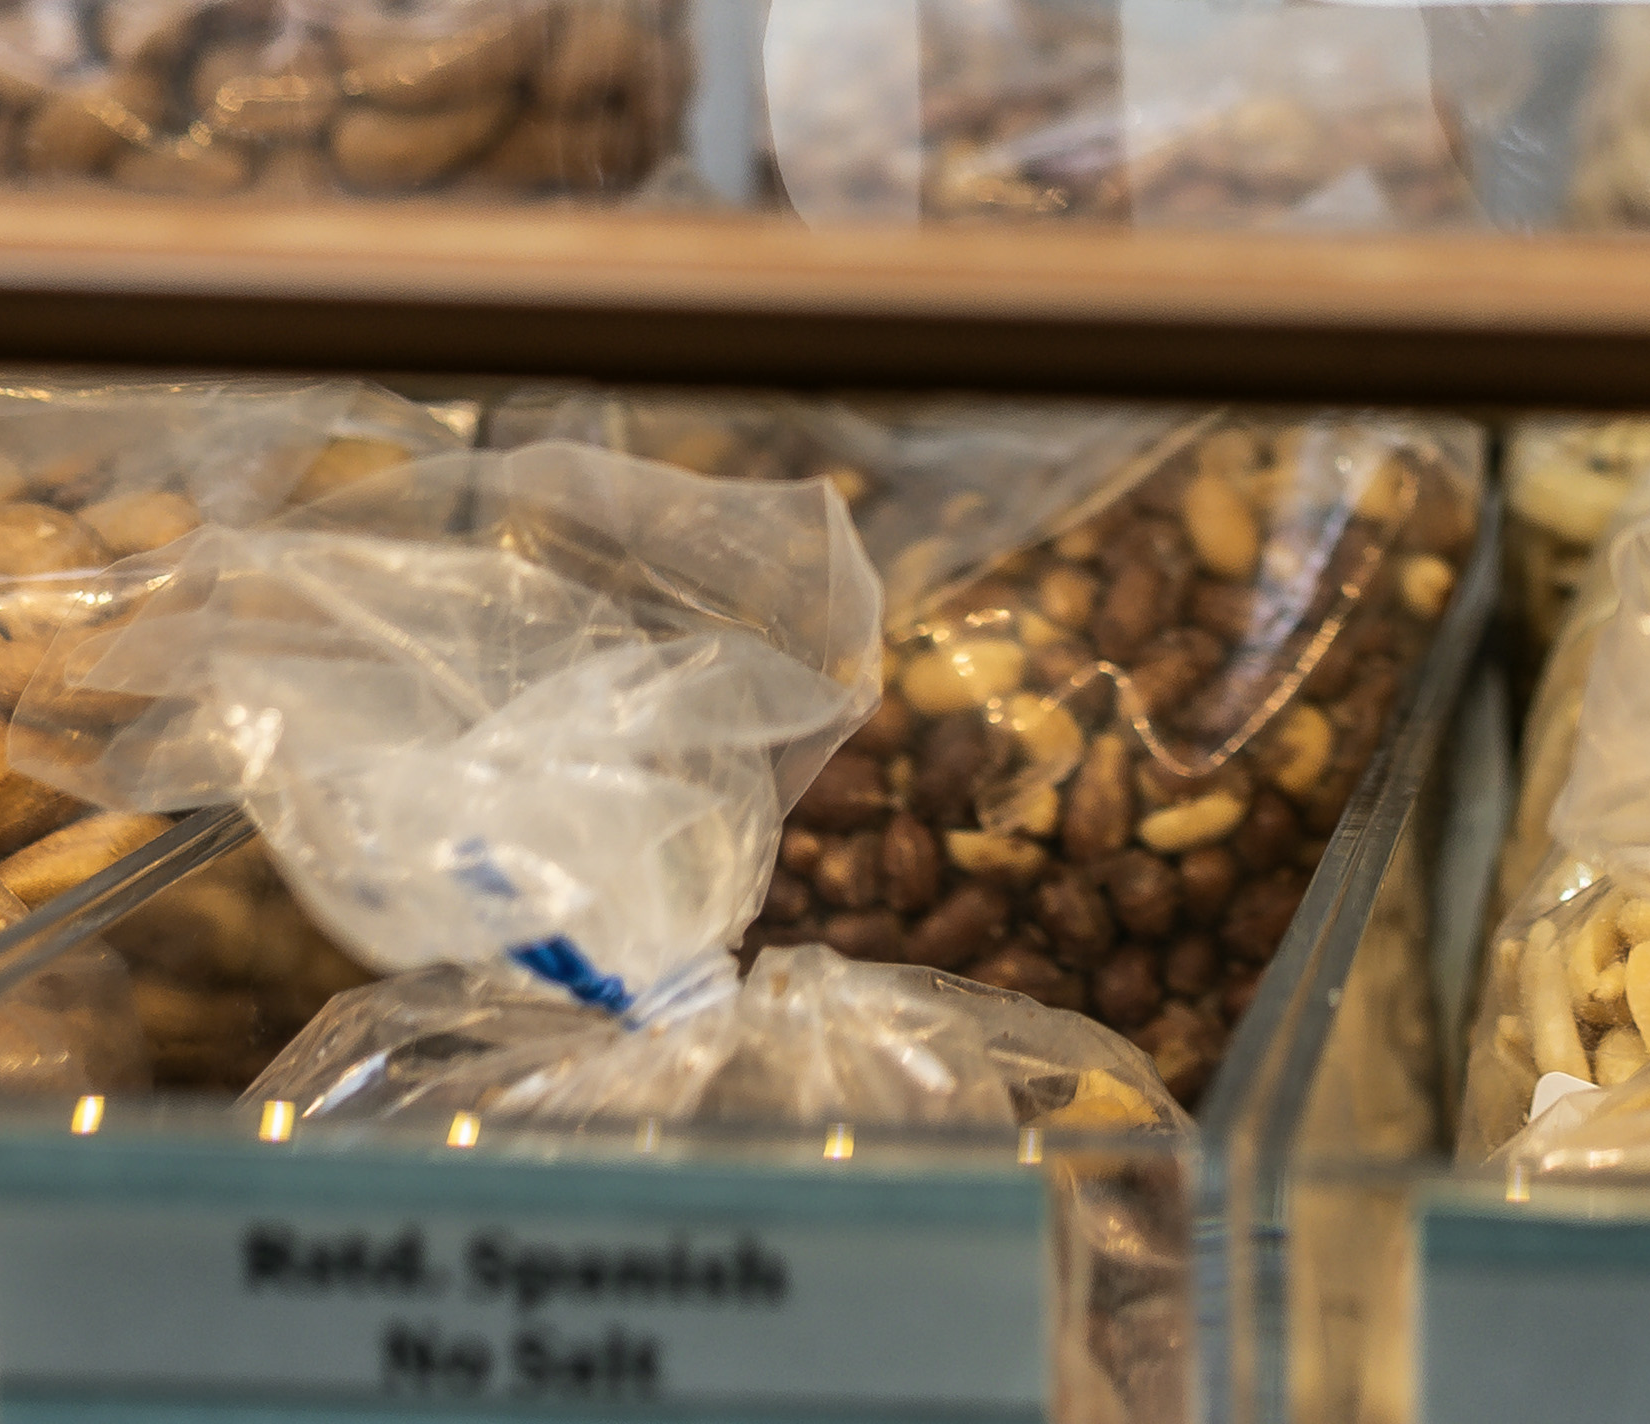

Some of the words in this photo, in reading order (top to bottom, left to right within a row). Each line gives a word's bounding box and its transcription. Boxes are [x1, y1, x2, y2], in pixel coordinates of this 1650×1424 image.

[466, 1229, 788, 1310] Spanish
[382, 1322, 492, 1395] No
[510, 1326, 660, 1397] Salt
